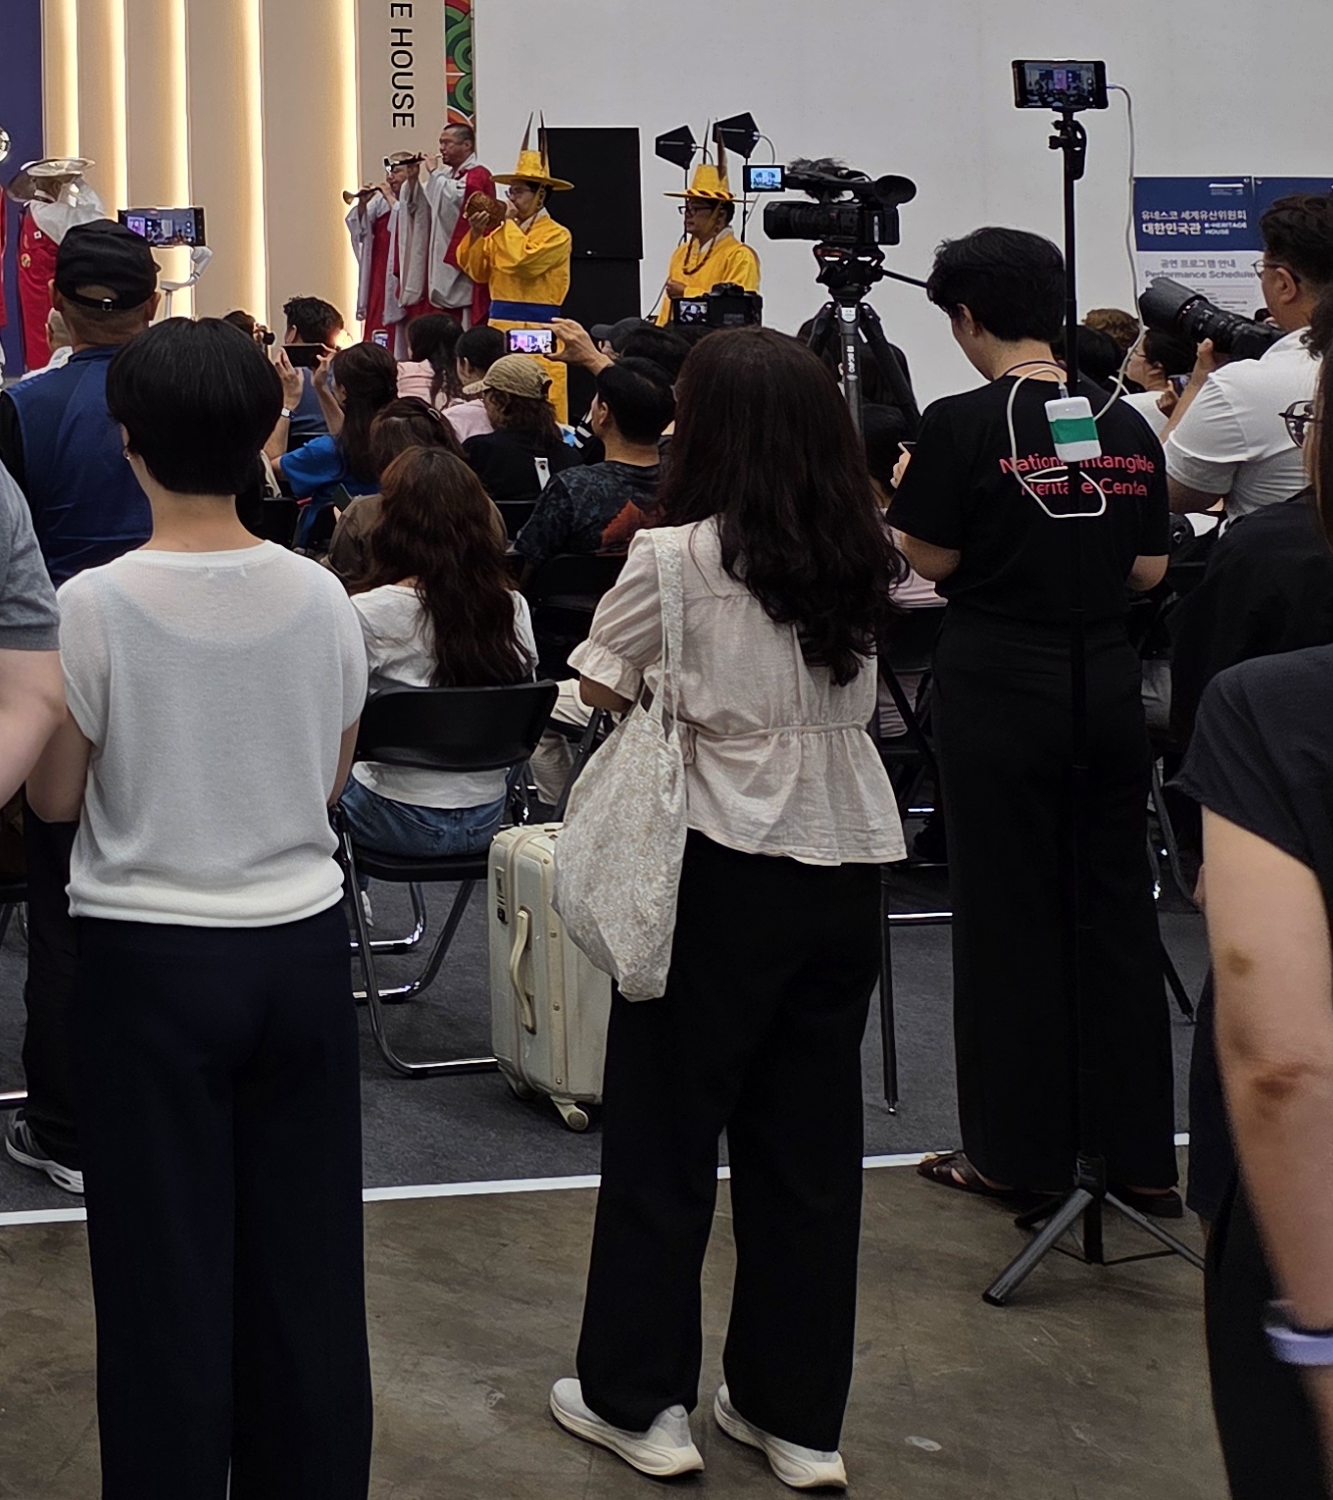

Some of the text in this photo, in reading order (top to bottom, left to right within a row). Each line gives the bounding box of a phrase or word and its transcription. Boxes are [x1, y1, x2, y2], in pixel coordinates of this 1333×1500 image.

[390, 28, 415, 129] HOUSE
[1141, 210, 1179, 220] 유네스코
[1142, 222, 1201, 235] 대한민국관
[999, 452, 1066, 474] Nation
[1021, 481, 1094, 496] Heritae
